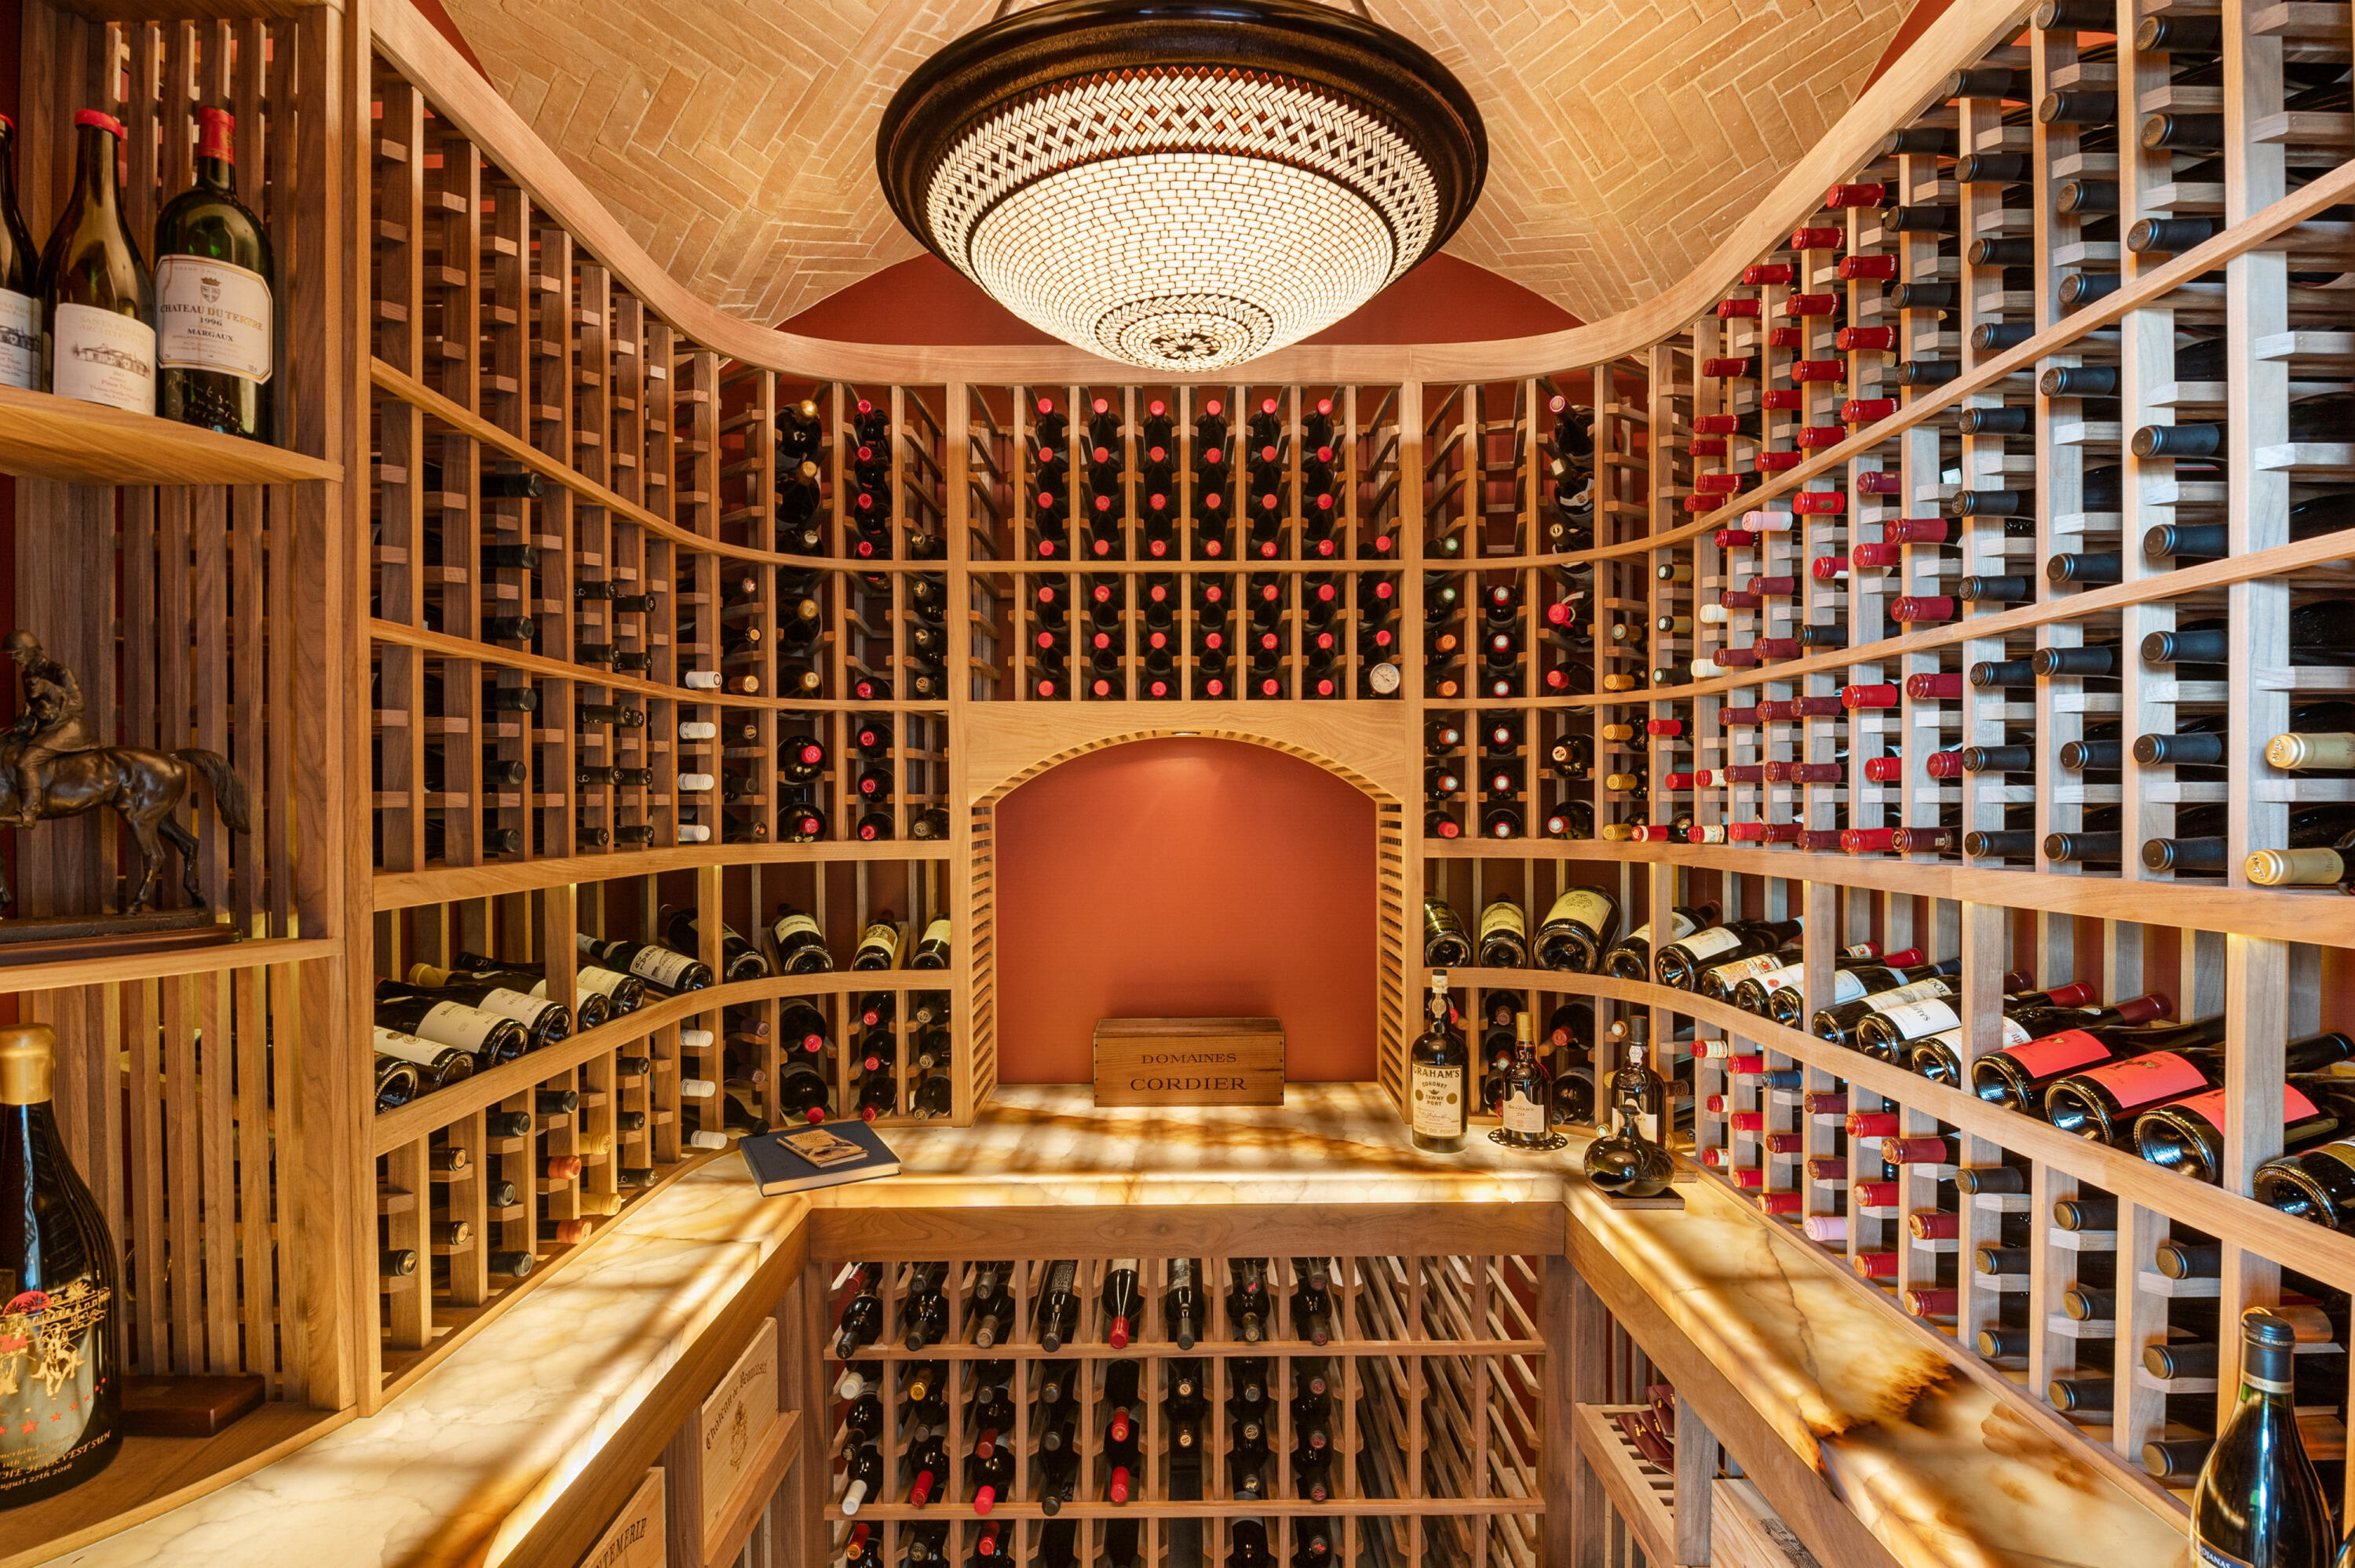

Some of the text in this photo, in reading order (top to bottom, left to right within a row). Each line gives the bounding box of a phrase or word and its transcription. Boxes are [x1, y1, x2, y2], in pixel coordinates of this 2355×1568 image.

[160, 304, 264, 331] CHATEAU DU TERTRE
[200, 317, 223, 326] 1996
[188, 328, 234, 342] MARGAUX
[1141, 1052, 1237, 1064] DOMAINES
[1413, 1066, 1460, 1078] GRAHAM'S
[1130, 1078, 1247, 1091] CORDIER
[90, 1429, 111, 1449] SUN
[29, 1469, 50, 1482] 27th
[52, 1462, 73, 1475] 2016
